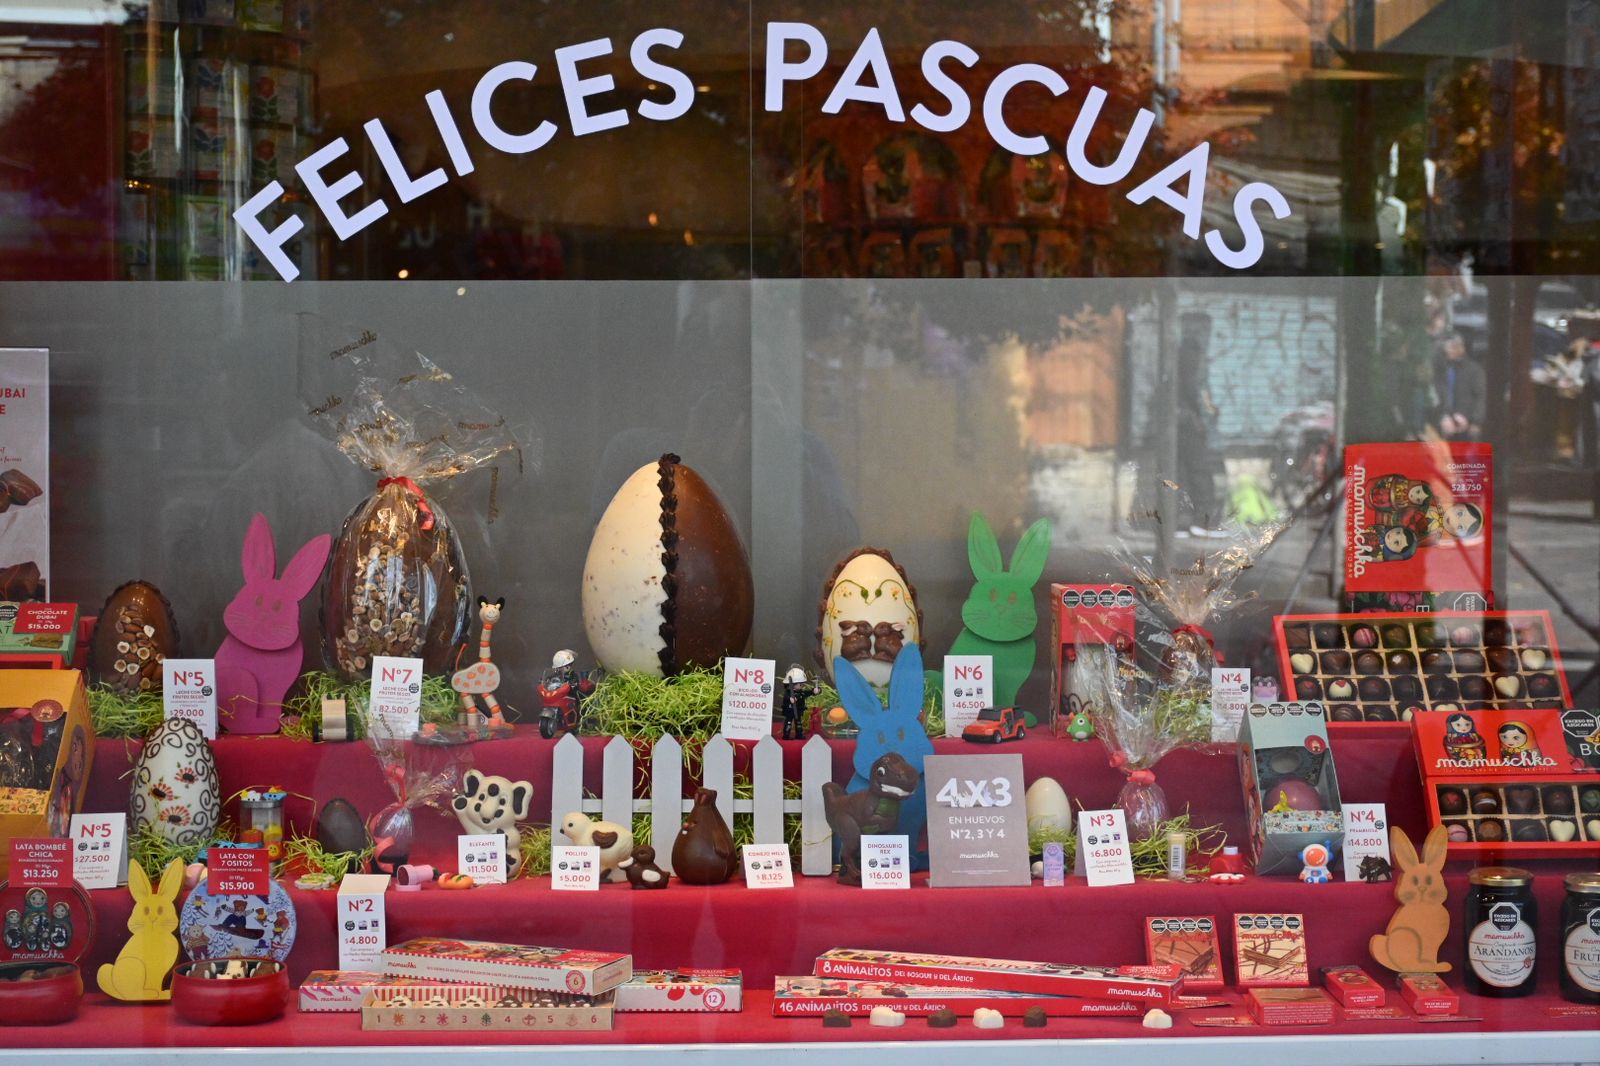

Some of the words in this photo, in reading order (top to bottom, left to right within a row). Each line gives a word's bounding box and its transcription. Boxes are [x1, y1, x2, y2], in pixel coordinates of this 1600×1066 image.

[233, 28, 695, 283] FELICES
[764, 21, 1292, 270] PASCUAS
[1353, 463, 1373, 579] mamuschka
[173, 671, 205, 687] N°5
[381, 667, 414, 684] N°7
[734, 668, 765, 685] N°8
[954, 665, 983, 680] N°6
[1221, 672, 1243, 684] N°4
[1435, 751, 1559, 769] mamuschka
[948, 816, 962, 824] EN
[965, 815, 1005, 824] HUEVOS
[1090, 814, 1115, 828] N°3
[1350, 809, 1376, 823] N°4
[81, 823, 112, 838] N°5
[977, 829, 984, 839] 3
[986, 829, 994, 838] Y
[997, 829, 1006, 838] 4
[23, 869, 59, 878] $13.250
[219, 881, 255, 890] $15.900
[348, 898, 374, 912] N°2
[1484, 932, 1525, 940] mamuschka
[12, 950, 64, 960] mamuschka
[823, 961, 831, 973] 8
[907, 971, 932, 980] BOSQUE
[708, 995, 718, 1003] 12
[1107, 987, 1163, 998] mamuschka
[779, 1001, 793, 1012] 16
[909, 1003, 921, 1011] DEL
[1081, 1002, 1138, 1012] mamuschka
[419, 1015, 426, 1023] 2
[462, 1015, 468, 1024] 3
[504, 1015, 511, 1023] 4
[547, 1015, 554, 1023] 5
[591, 1015, 597, 1023] 6
